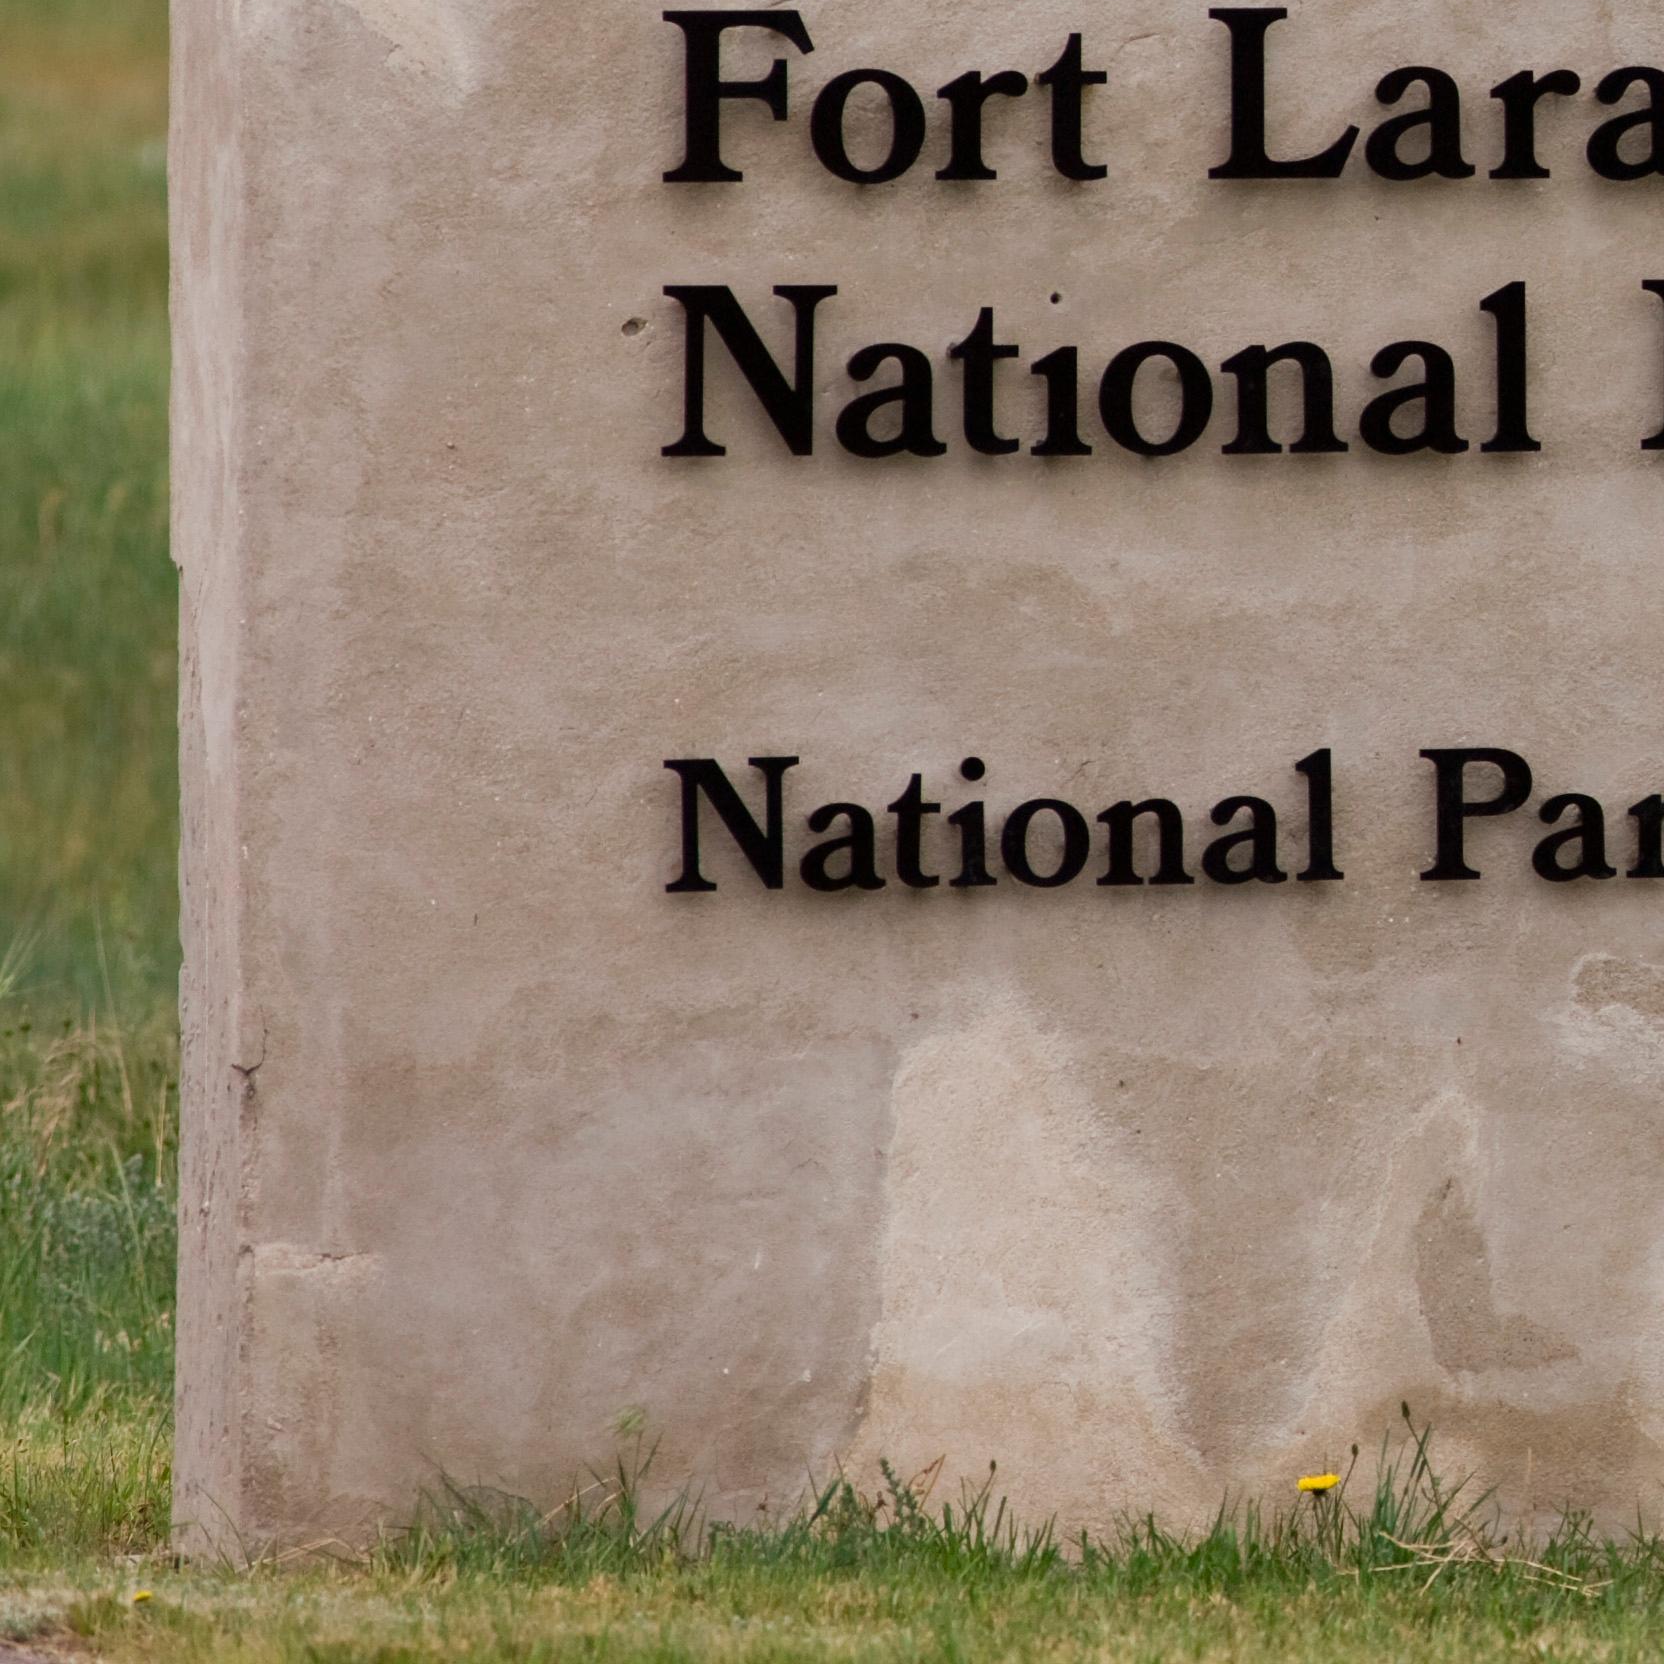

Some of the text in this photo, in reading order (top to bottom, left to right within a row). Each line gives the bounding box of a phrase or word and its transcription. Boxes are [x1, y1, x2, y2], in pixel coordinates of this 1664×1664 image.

[664, 10, 1108, 187] Fort
[662, 281, 1542, 460] National
[665, 748, 1344, 893] National
